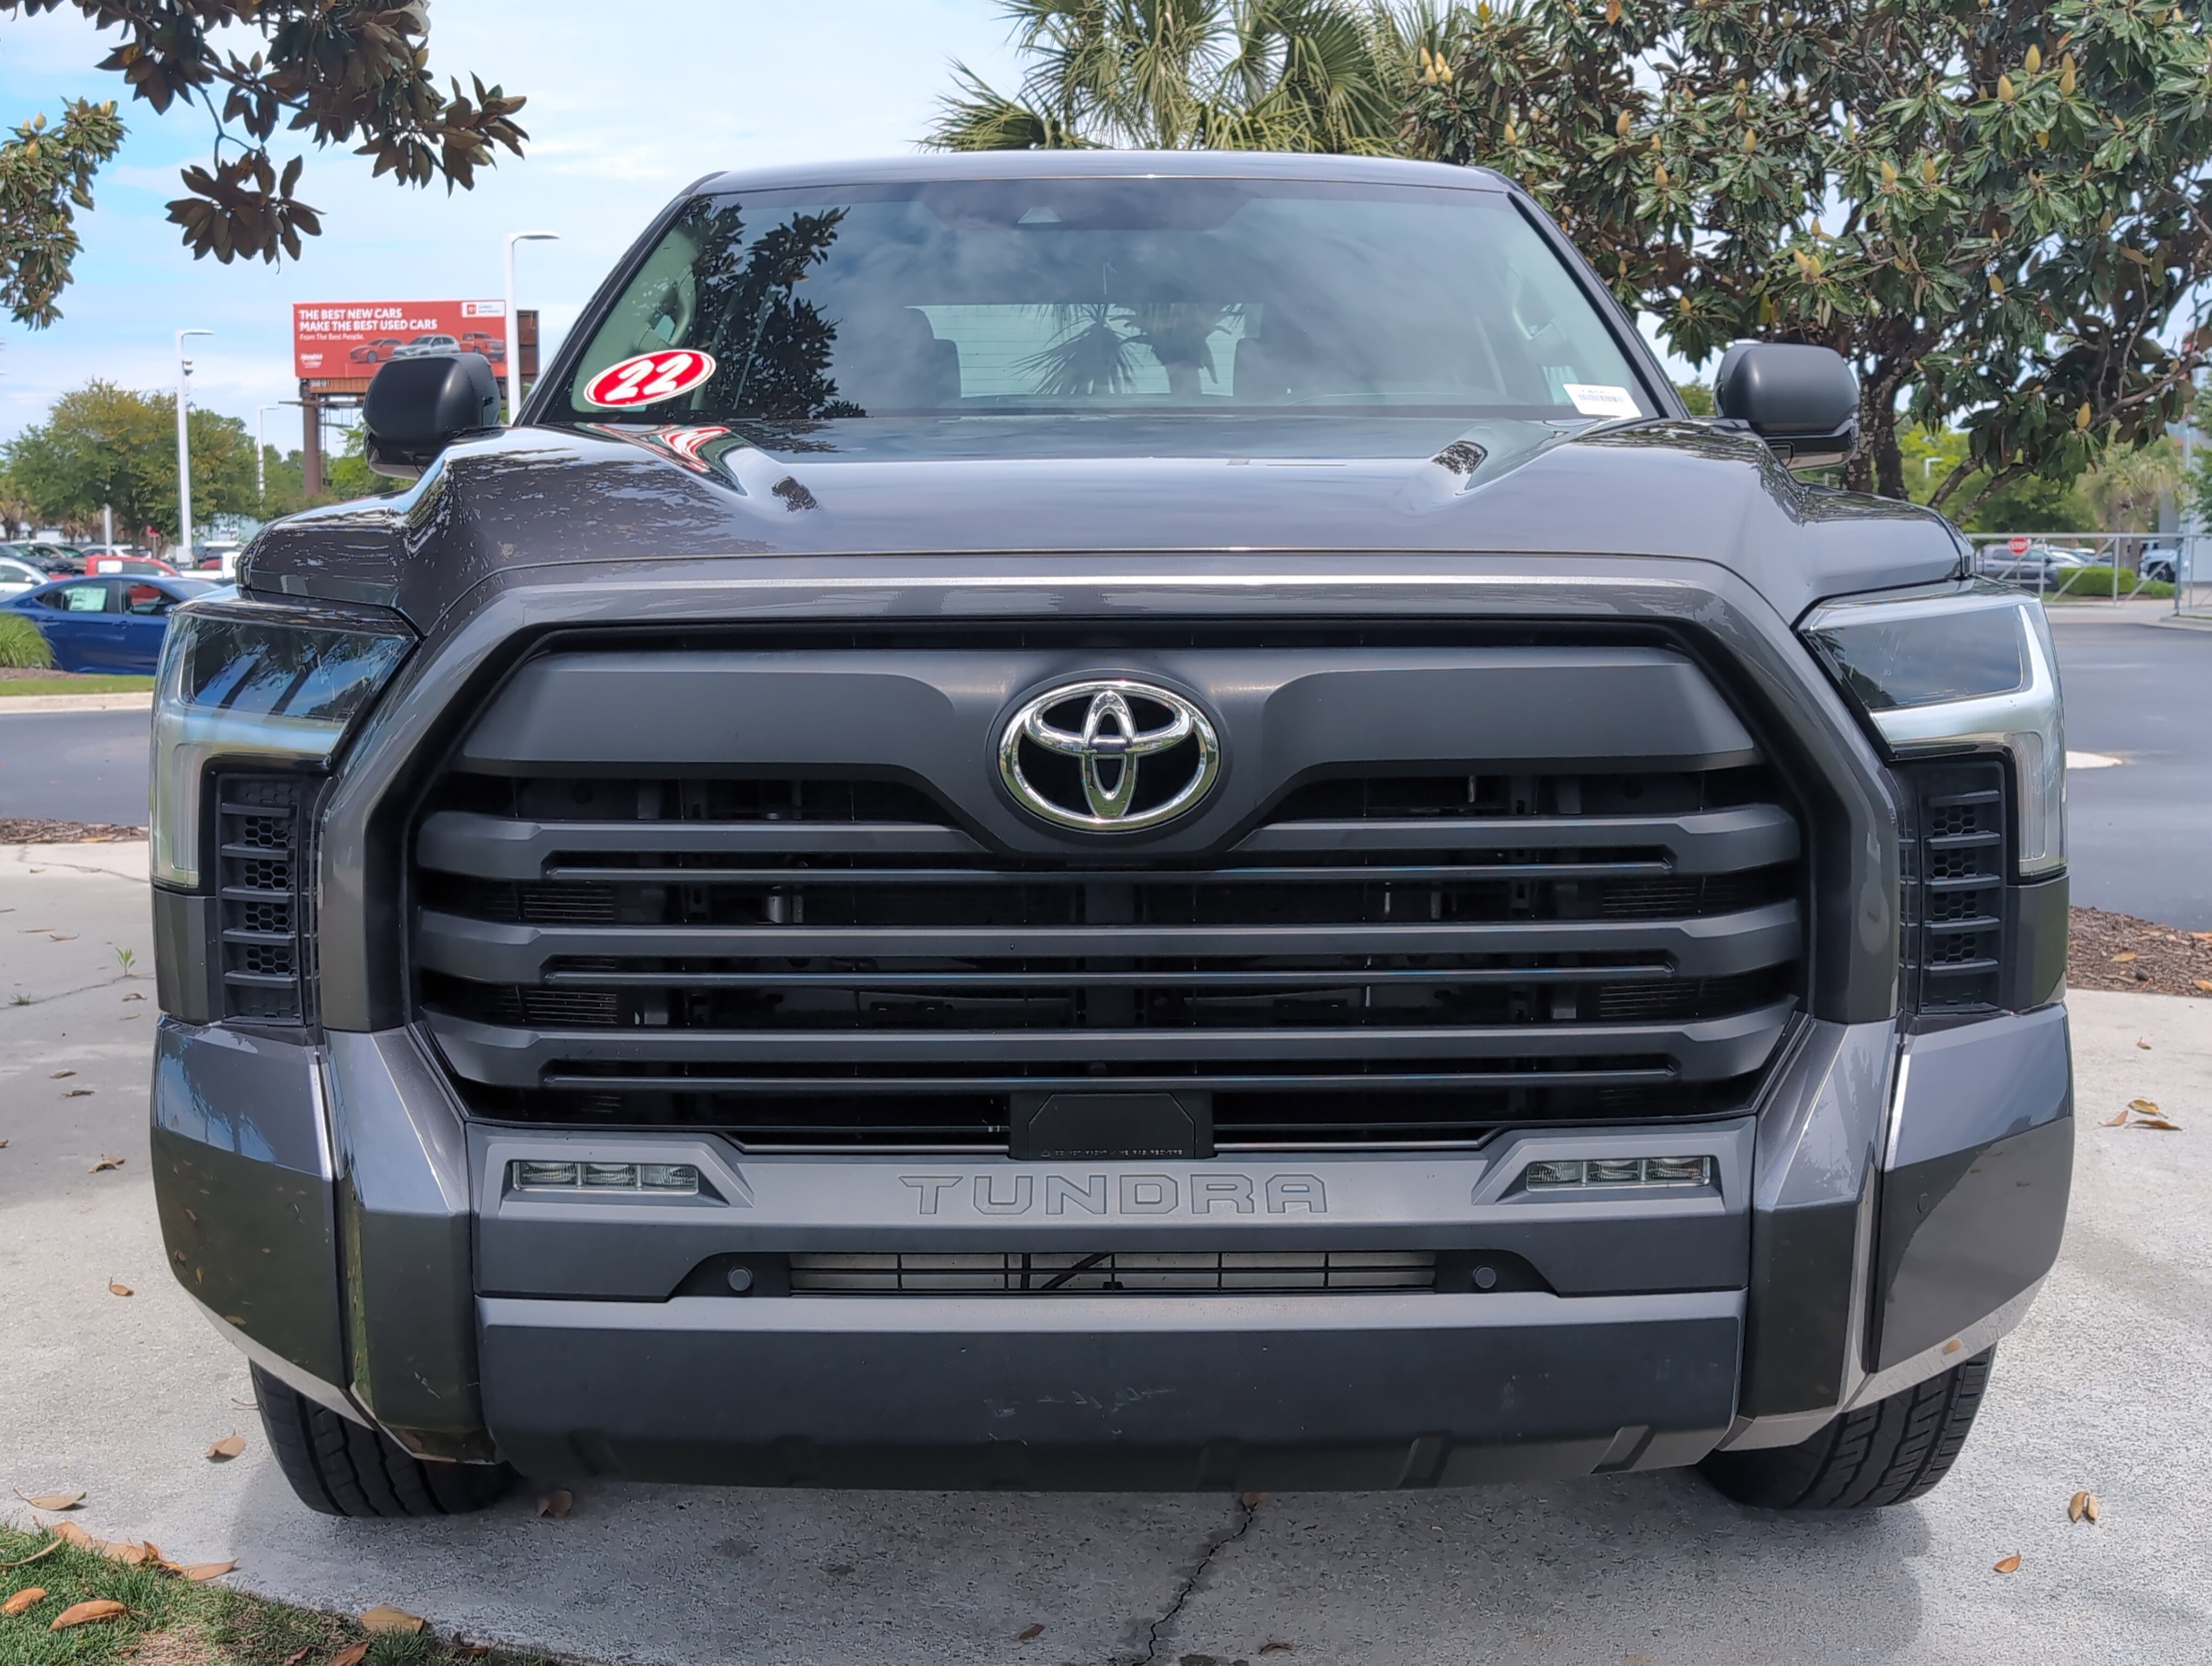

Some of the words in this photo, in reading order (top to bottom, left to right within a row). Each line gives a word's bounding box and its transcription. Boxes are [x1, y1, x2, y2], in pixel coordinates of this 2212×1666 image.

[300, 309, 319, 320] THE
[321, 309, 345, 320] BEST
[347, 308, 372, 319] NEW
[374, 307, 402, 319] CARS
[300, 321, 330, 331] MAKE
[331, 320, 351, 331] THE
[353, 319, 378, 331] BEST
[380, 319, 408, 331] USED
[409, 318, 438, 330] CARS
[605, 354, 693, 402] 22
[2010, 541, 2028, 549] STOP
[898, 1174, 1328, 1215] TUNDRA
